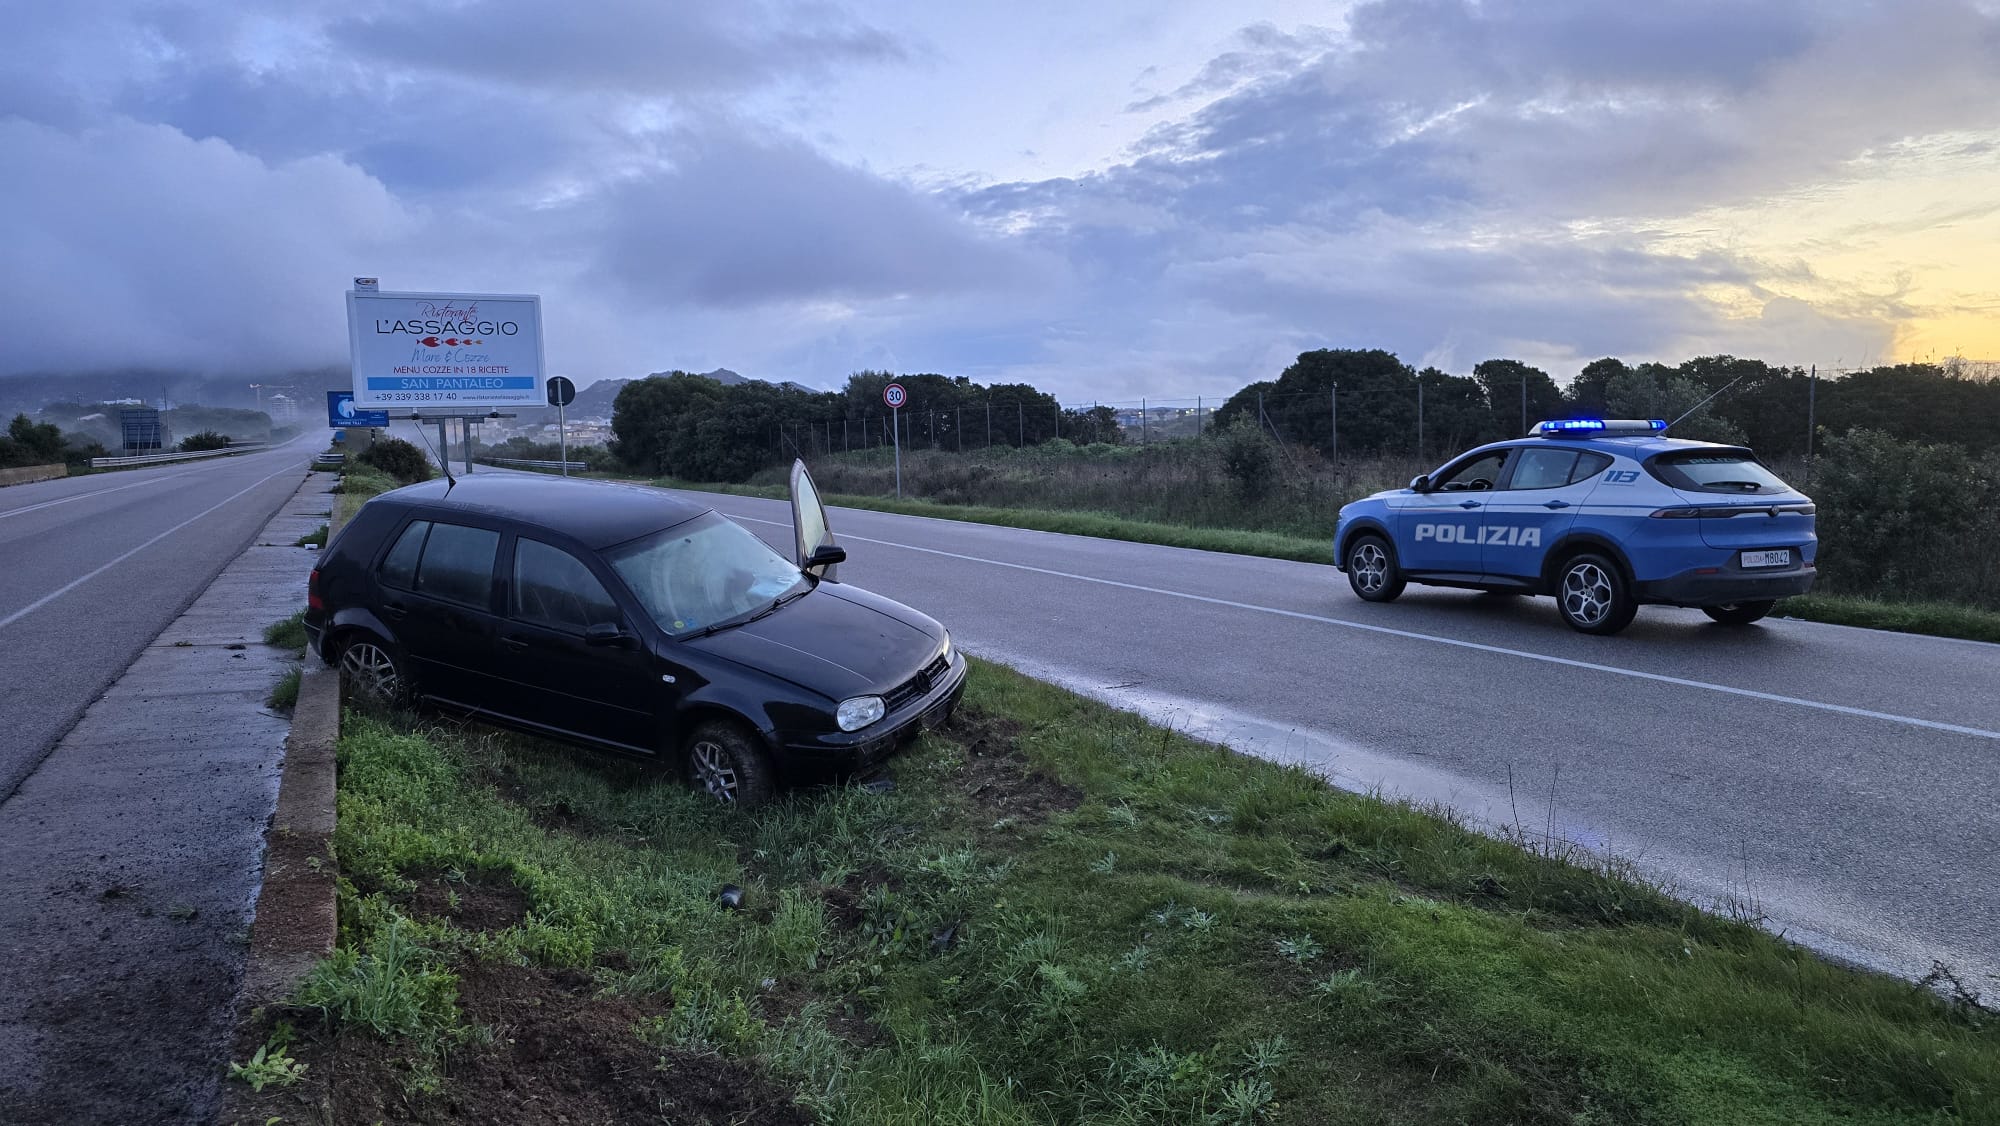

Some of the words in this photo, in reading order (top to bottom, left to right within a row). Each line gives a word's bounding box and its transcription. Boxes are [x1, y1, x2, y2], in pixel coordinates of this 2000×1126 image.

[416, 301, 478, 326] Ristorante
[376, 319, 519, 336] L'ASSAGGIO
[422, 366, 451, 374] COZZE
[453, 366, 463, 374] IN
[467, 366, 476, 374] 18
[479, 366, 509, 374] RICETTE
[401, 378, 429, 389] SAN
[436, 378, 504, 389] PANTALEO
[375, 393, 392, 401] +39
[395, 393, 412, 401] 339
[414, 393, 430, 401] 338
[434, 393, 443, 401] 17
[446, 393, 457, 401] 40
[889, 390, 902, 401] 30
[1604, 470, 1640, 482] 113
[1415, 524, 1541, 547] POLIZIA
